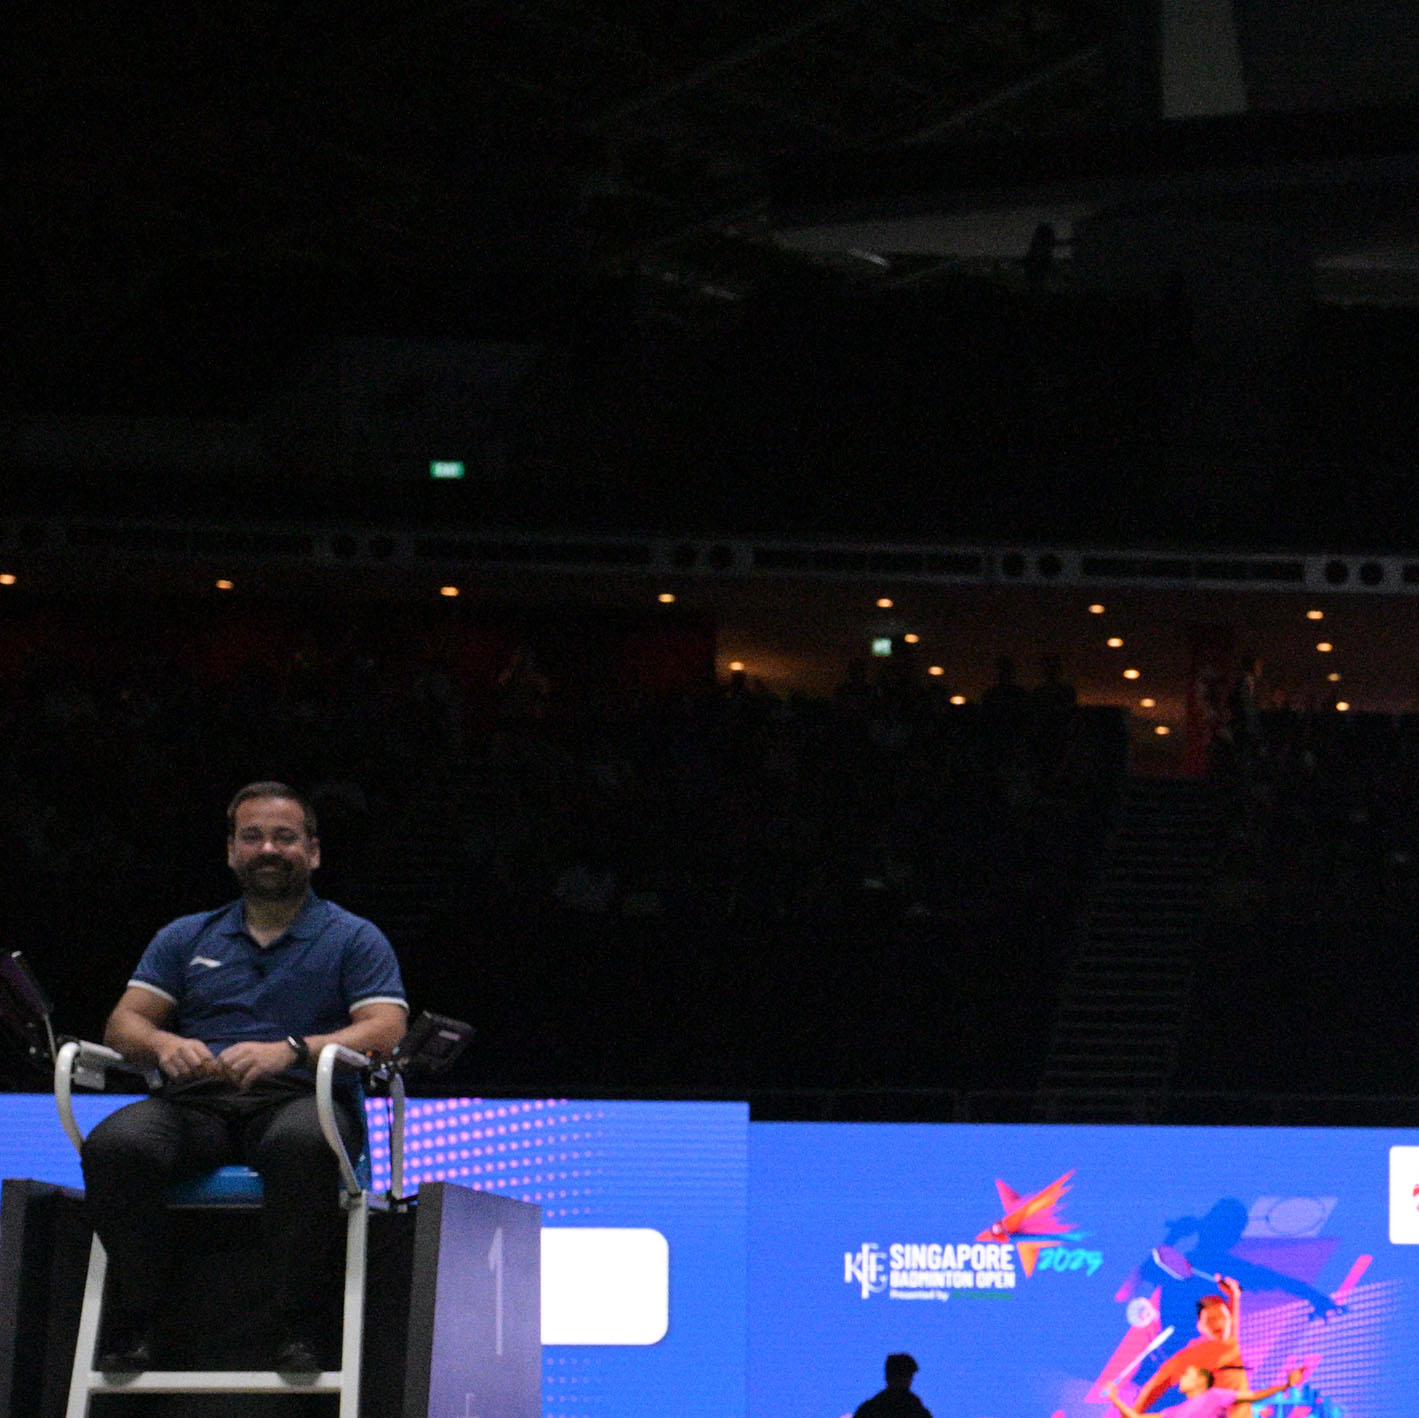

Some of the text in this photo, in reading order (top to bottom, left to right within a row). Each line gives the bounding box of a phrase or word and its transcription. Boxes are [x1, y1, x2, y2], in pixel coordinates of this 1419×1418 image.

[889, 1243, 1016, 1272] SINGAPORE
[1037, 1246, 1104, 1277] 2024
[488, 1227, 504, 1357] 1
[889, 1270, 1016, 1289] BADMINTON OPEN
